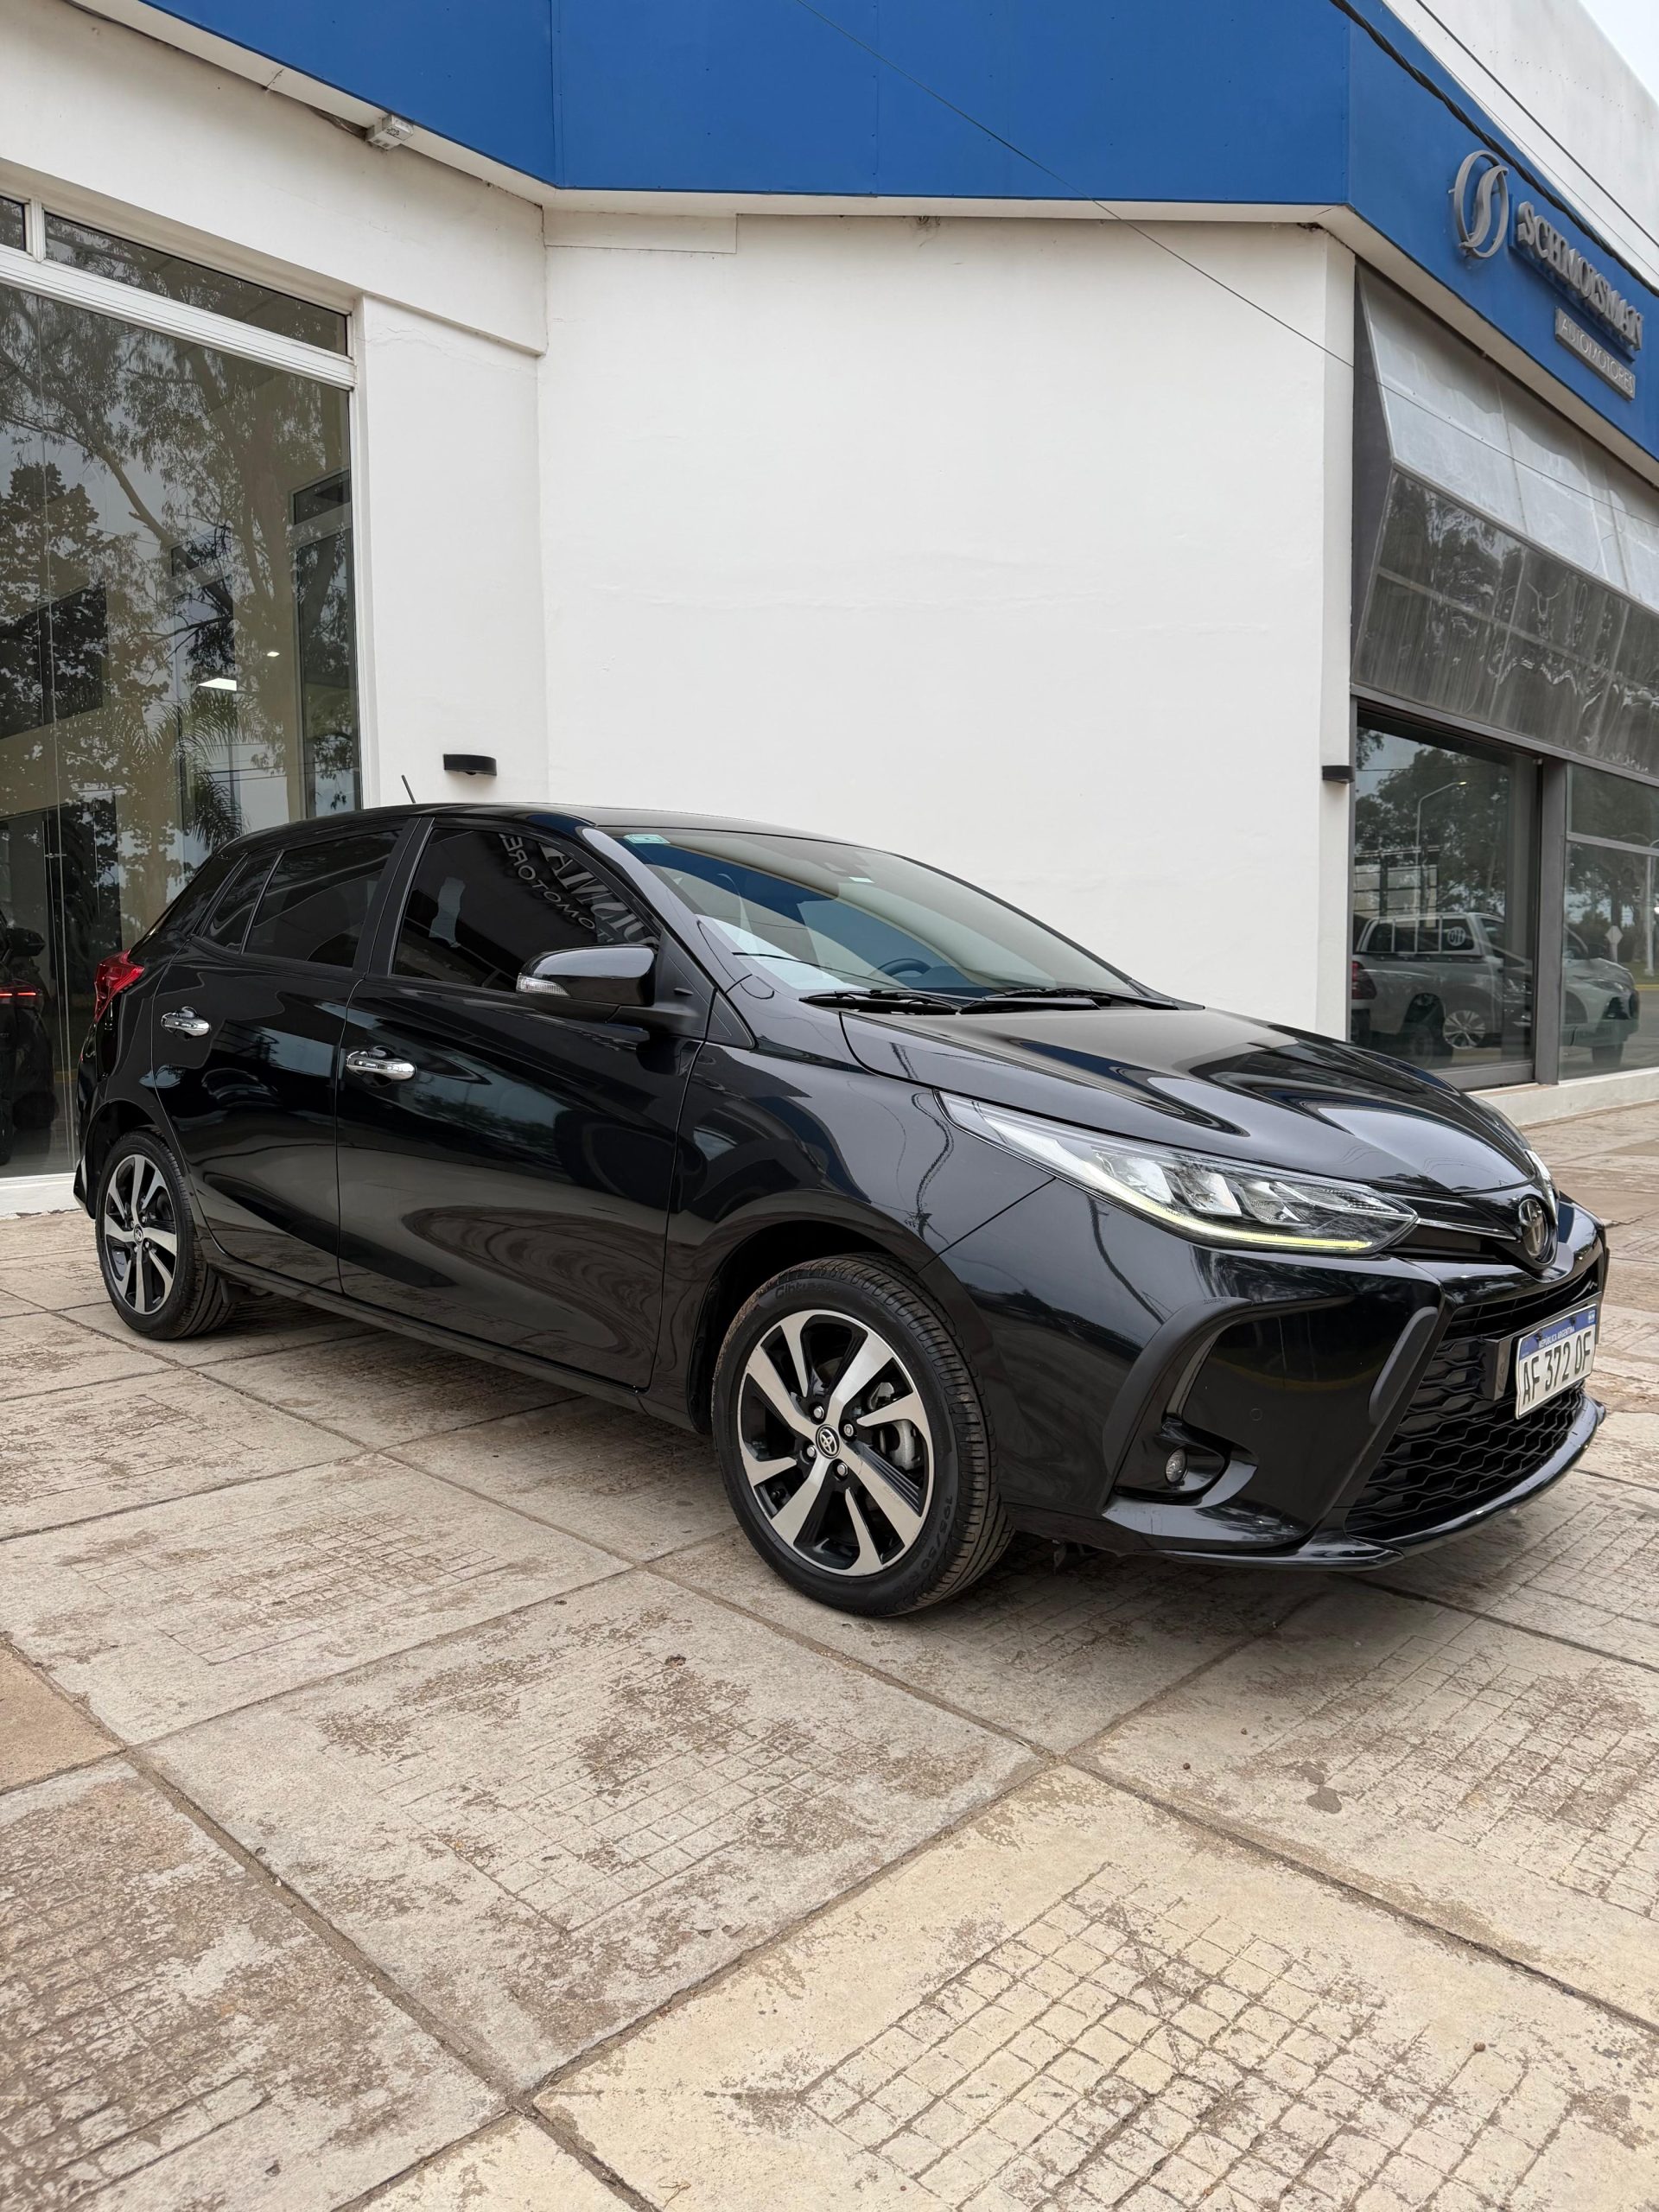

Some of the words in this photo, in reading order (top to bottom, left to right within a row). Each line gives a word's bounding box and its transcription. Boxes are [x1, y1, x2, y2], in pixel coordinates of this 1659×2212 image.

[1560, 316, 1635, 395] AUTOMOTORES
[1522, 1355, 1540, 1406] AF
[1544, 1341, 1571, 1392] 372
